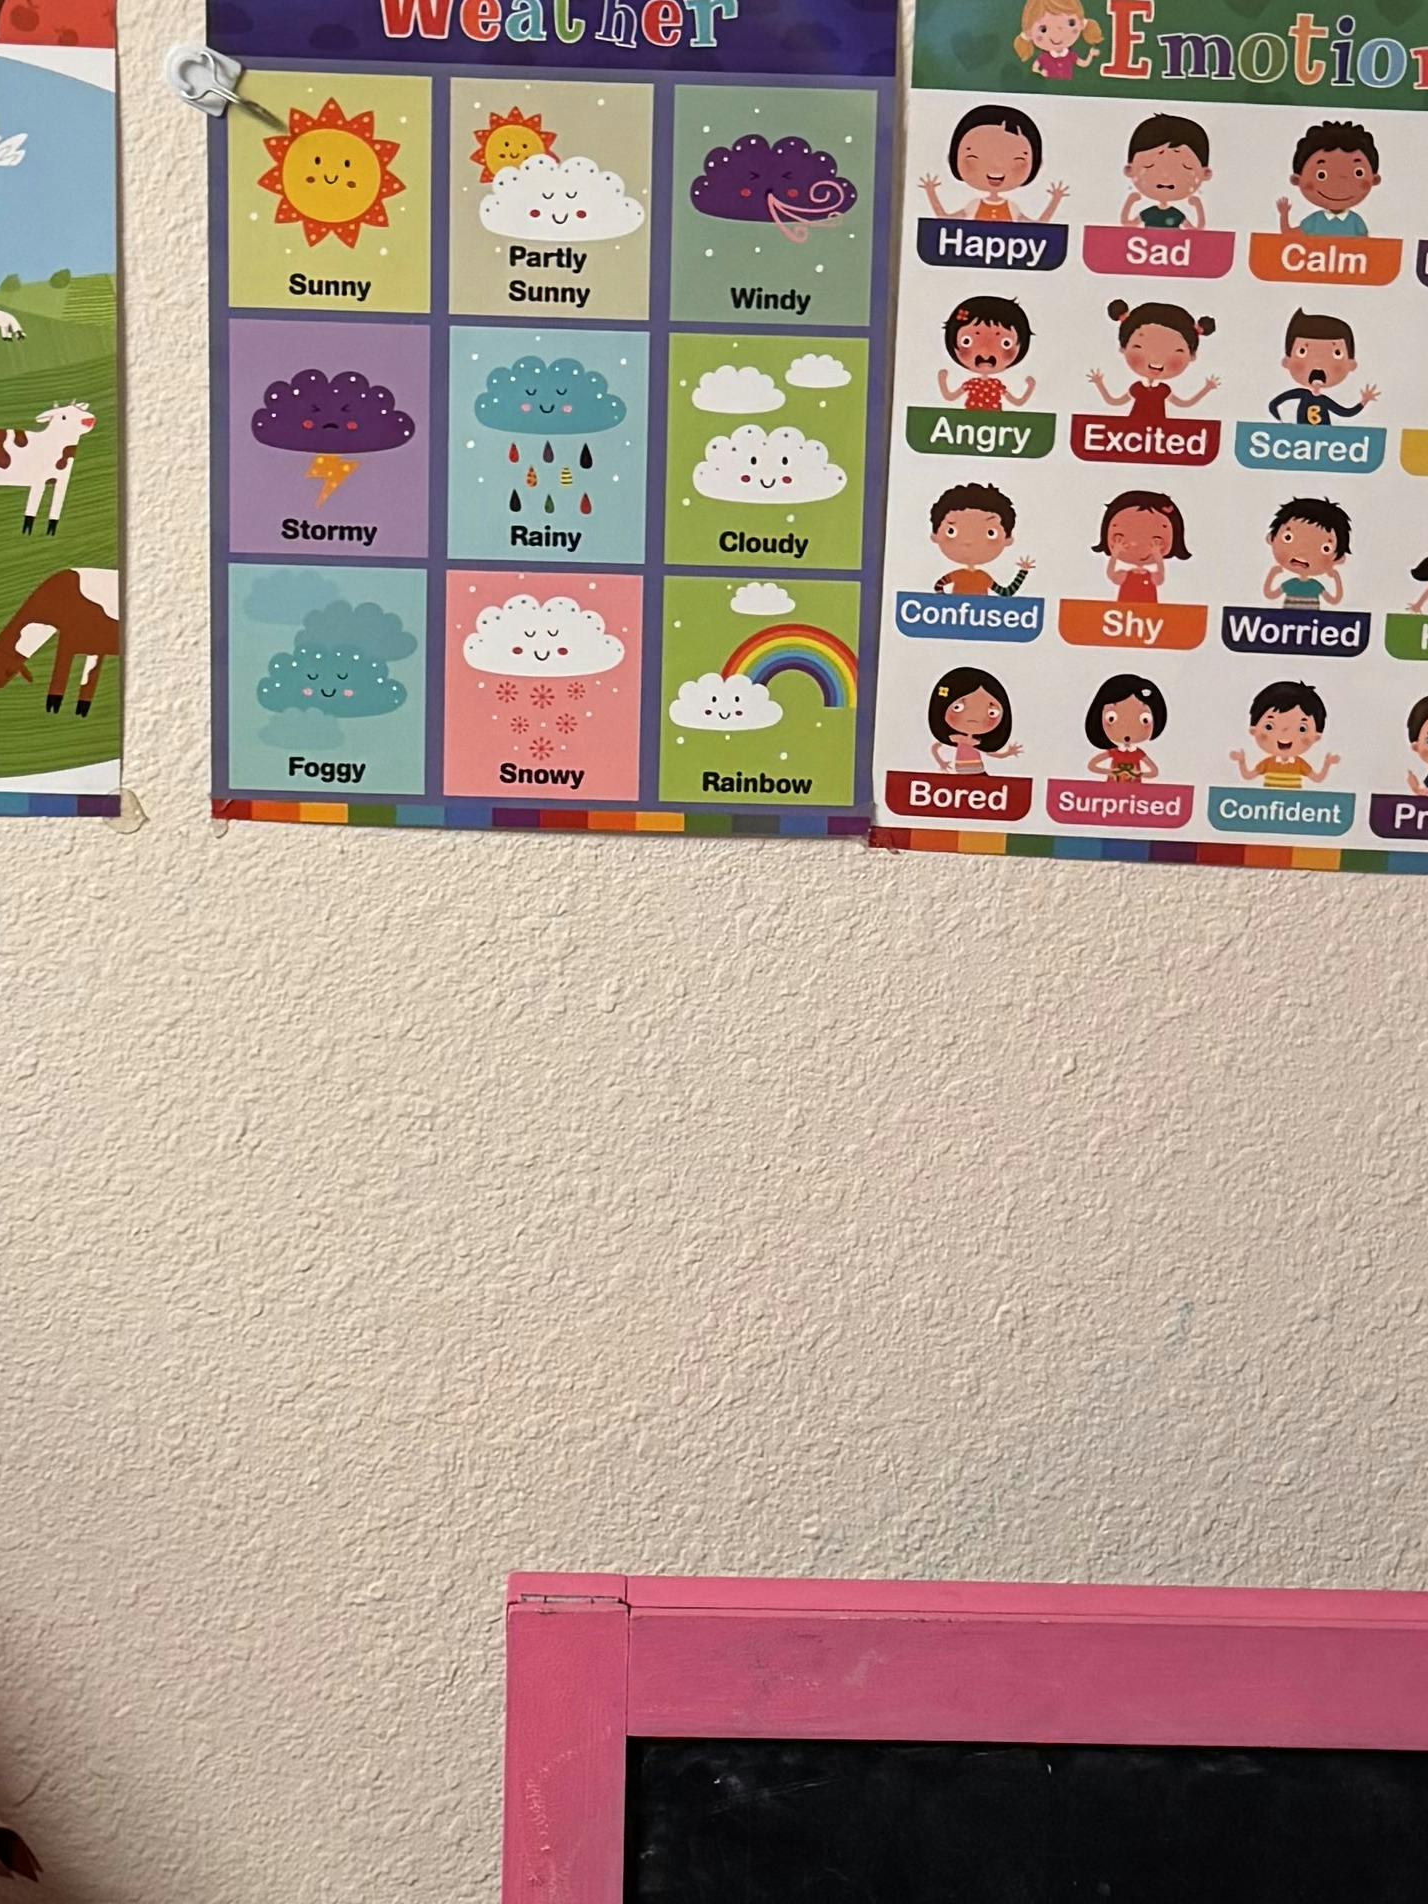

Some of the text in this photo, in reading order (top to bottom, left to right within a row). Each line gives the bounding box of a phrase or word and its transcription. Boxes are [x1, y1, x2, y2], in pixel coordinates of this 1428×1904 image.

[508, 246, 588, 272] Partly
[938, 228, 1047, 265] Happy
[1126, 237, 1191, 267] Sad
[1281, 244, 1367, 275] Calm
[288, 273, 372, 302] Sunny
[508, 279, 591, 308] Sunny
[730, 287, 811, 315] Windy
[929, 422, 1032, 454] Angry
[1084, 423, 1207, 456] Excited
[1248, 430, 1370, 463] Scared
[281, 518, 378, 546] Stormy
[900, 600, 1039, 630] Confused
[1229, 617, 1361, 649] Worried
[288, 756, 366, 785] Foggy
[701, 771, 813, 795] Rainbow
[1058, 792, 1181, 818] Surprised
[1219, 799, 1342, 824] Confident
